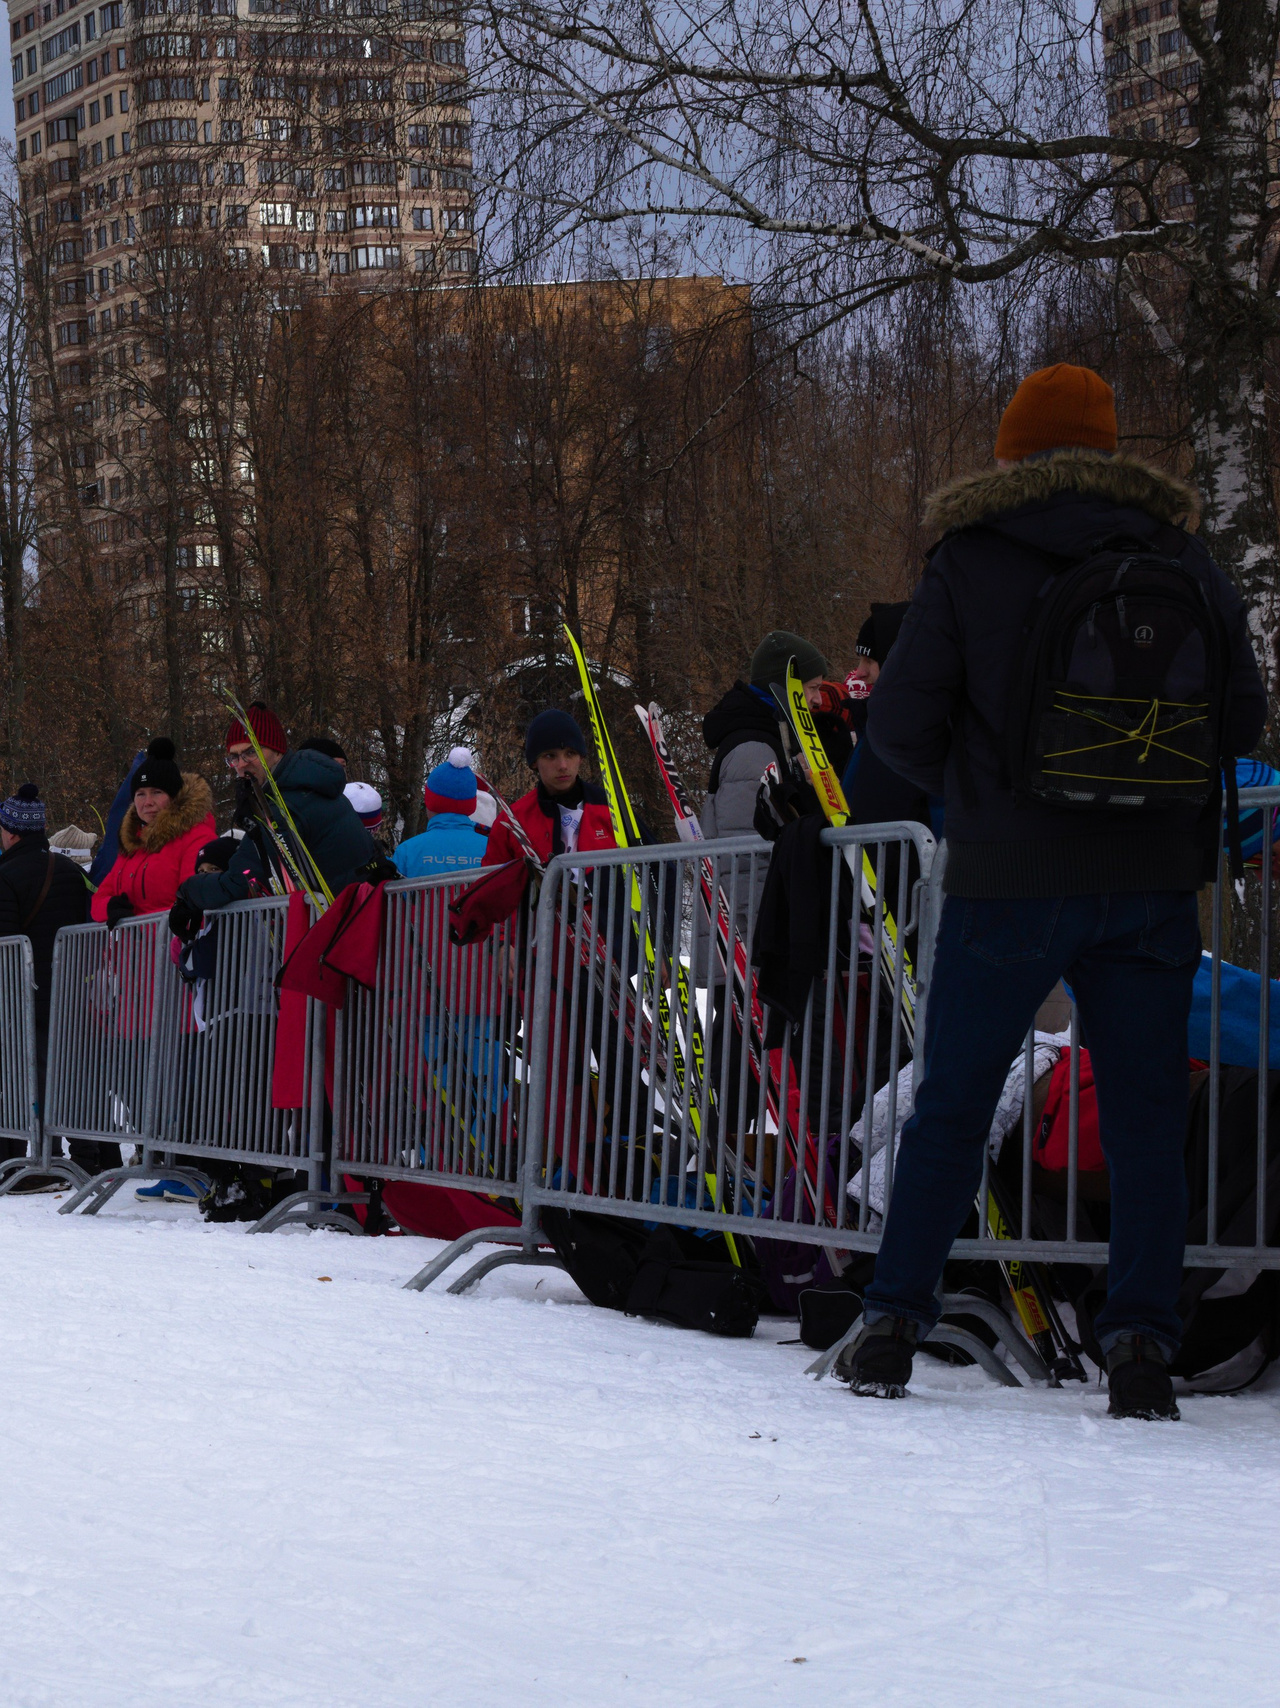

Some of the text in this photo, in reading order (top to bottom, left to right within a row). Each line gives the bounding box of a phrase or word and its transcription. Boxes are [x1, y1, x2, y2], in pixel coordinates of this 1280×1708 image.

[792, 690, 829, 771] CHER
[653, 740, 695, 819] OMIC
[422, 855, 482, 865] RUSSIA
